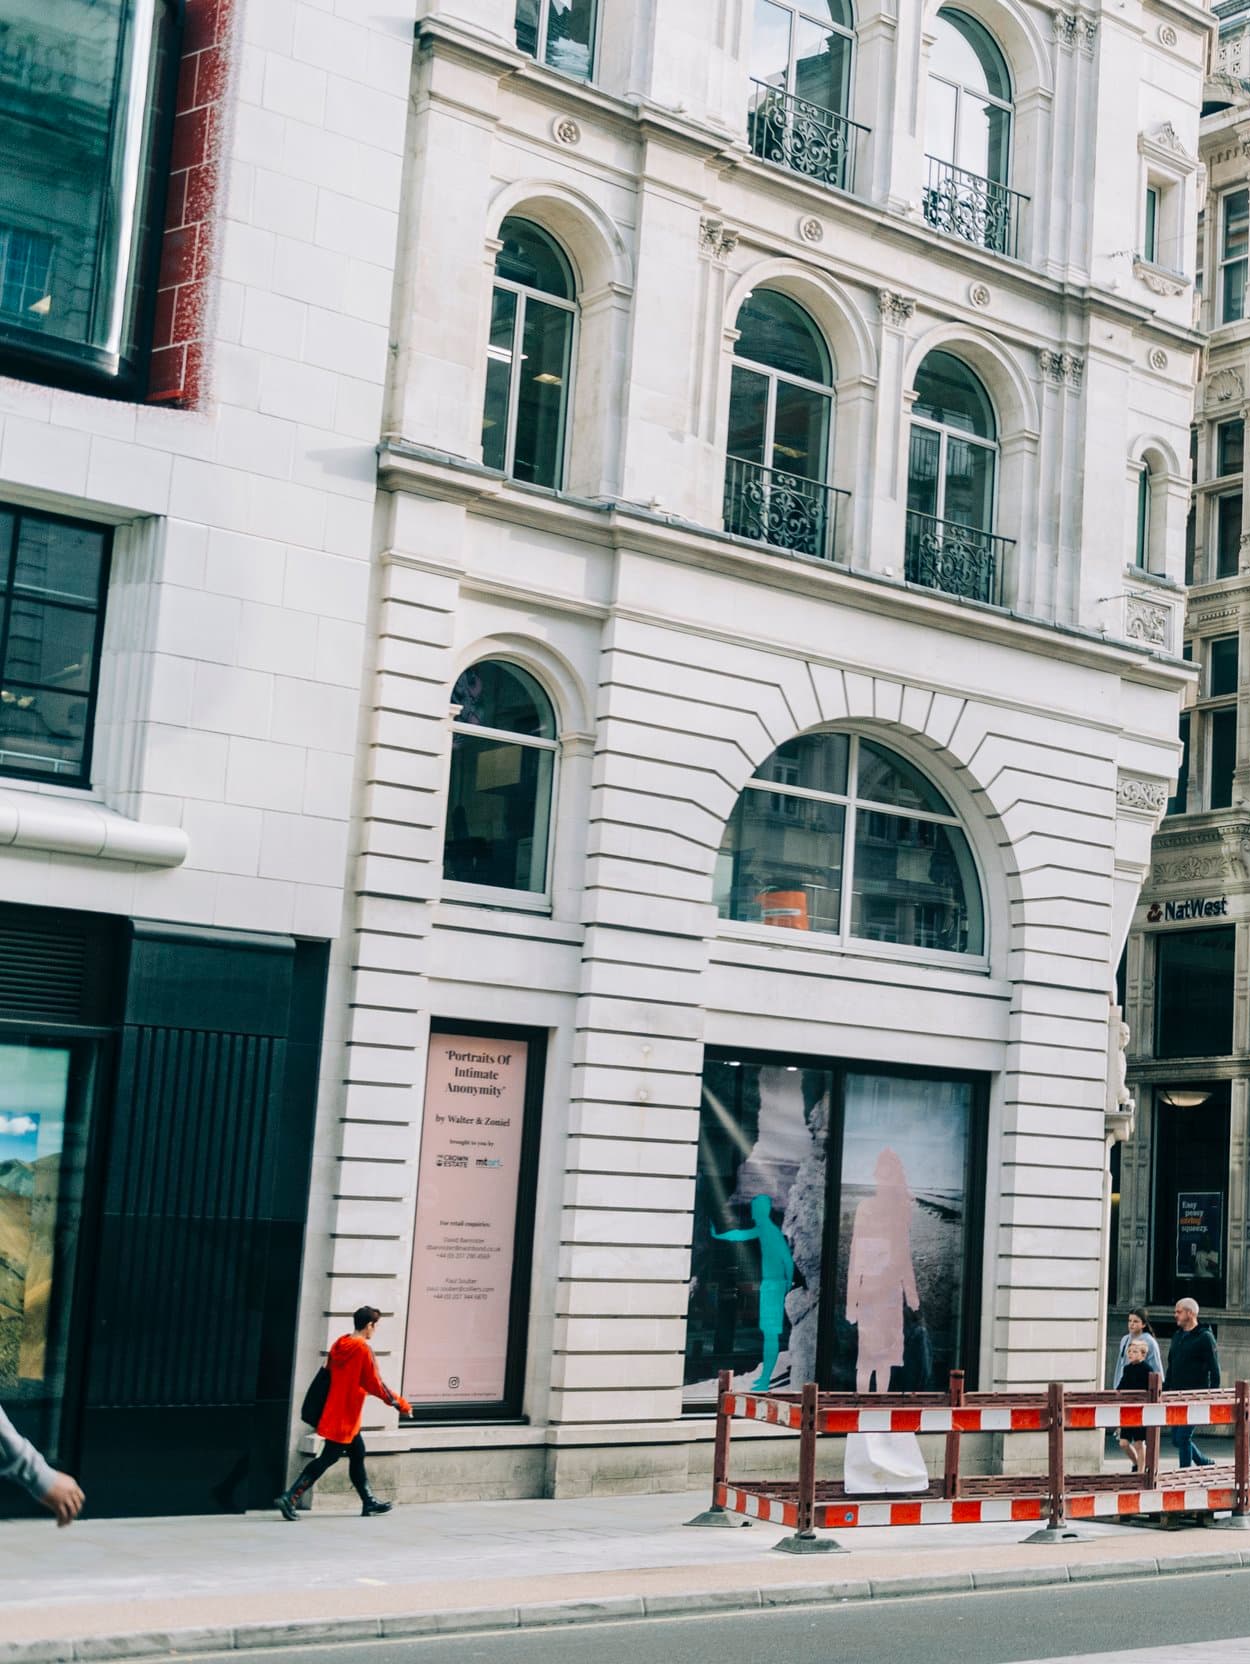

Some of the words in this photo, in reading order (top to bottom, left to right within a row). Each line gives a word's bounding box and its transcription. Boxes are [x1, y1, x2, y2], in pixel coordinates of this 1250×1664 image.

[1165, 897, 1227, 920] NatWest
[497, 1054, 513, 1065] Of
[455, 1067, 500, 1080] Intimate
[435, 1114, 445, 1124] by
[447, 1115, 473, 1125] Walter
